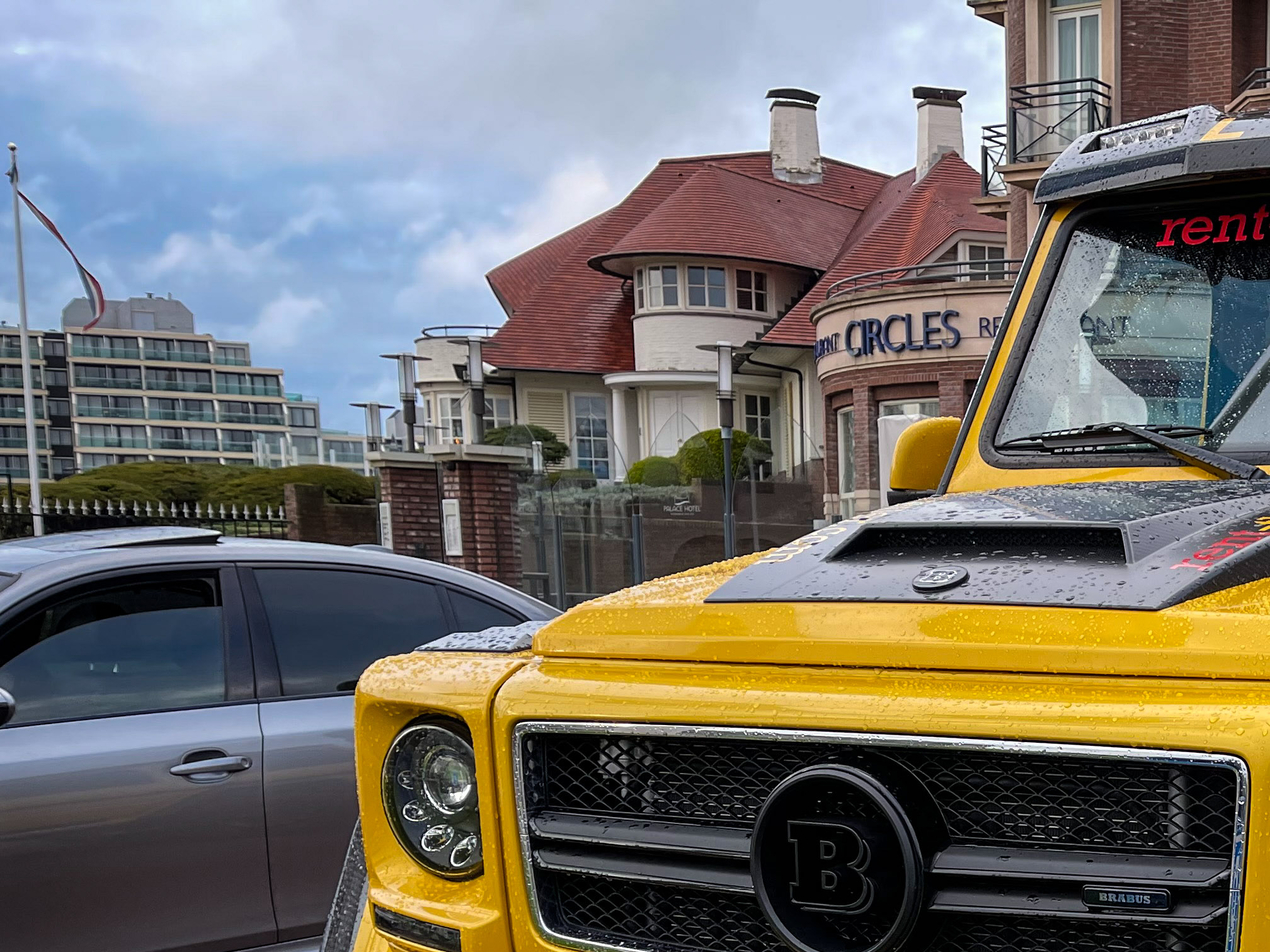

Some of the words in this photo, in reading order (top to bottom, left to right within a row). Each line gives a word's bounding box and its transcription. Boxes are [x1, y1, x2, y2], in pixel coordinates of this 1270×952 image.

[844, 309, 961, 358] CIRCLES
[787, 820, 873, 914] B
[1099, 892, 1151, 905] BRABUS
